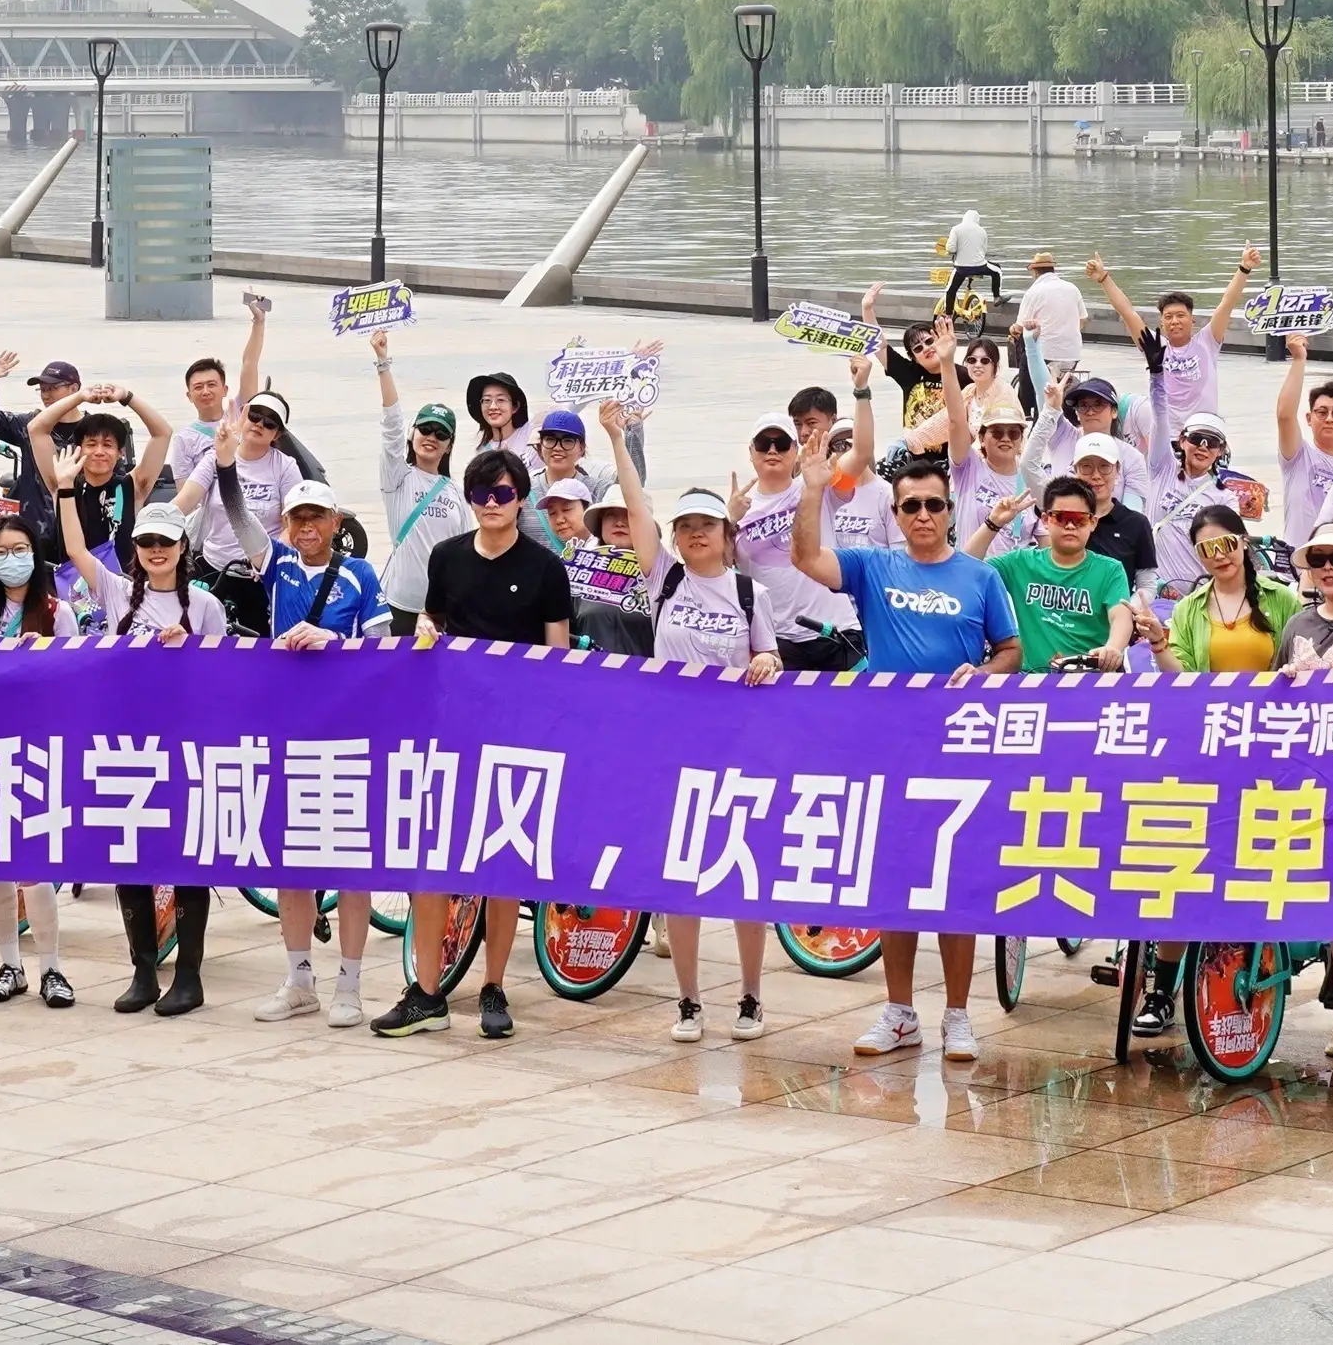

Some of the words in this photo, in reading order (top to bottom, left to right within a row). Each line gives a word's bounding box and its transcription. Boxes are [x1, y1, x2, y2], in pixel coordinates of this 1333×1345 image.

[795, 312, 878, 341] 科学减重一亿斤
[1262, 314, 1323, 329] 减重先锋
[799, 327, 865, 353] 天津在行动
[556, 360, 626, 379] 科学减重
[565, 376, 628, 394] 骑乐无穷
[1026, 583, 1093, 615] PUMA
[669, 606, 744, 636] 减重扛把子
